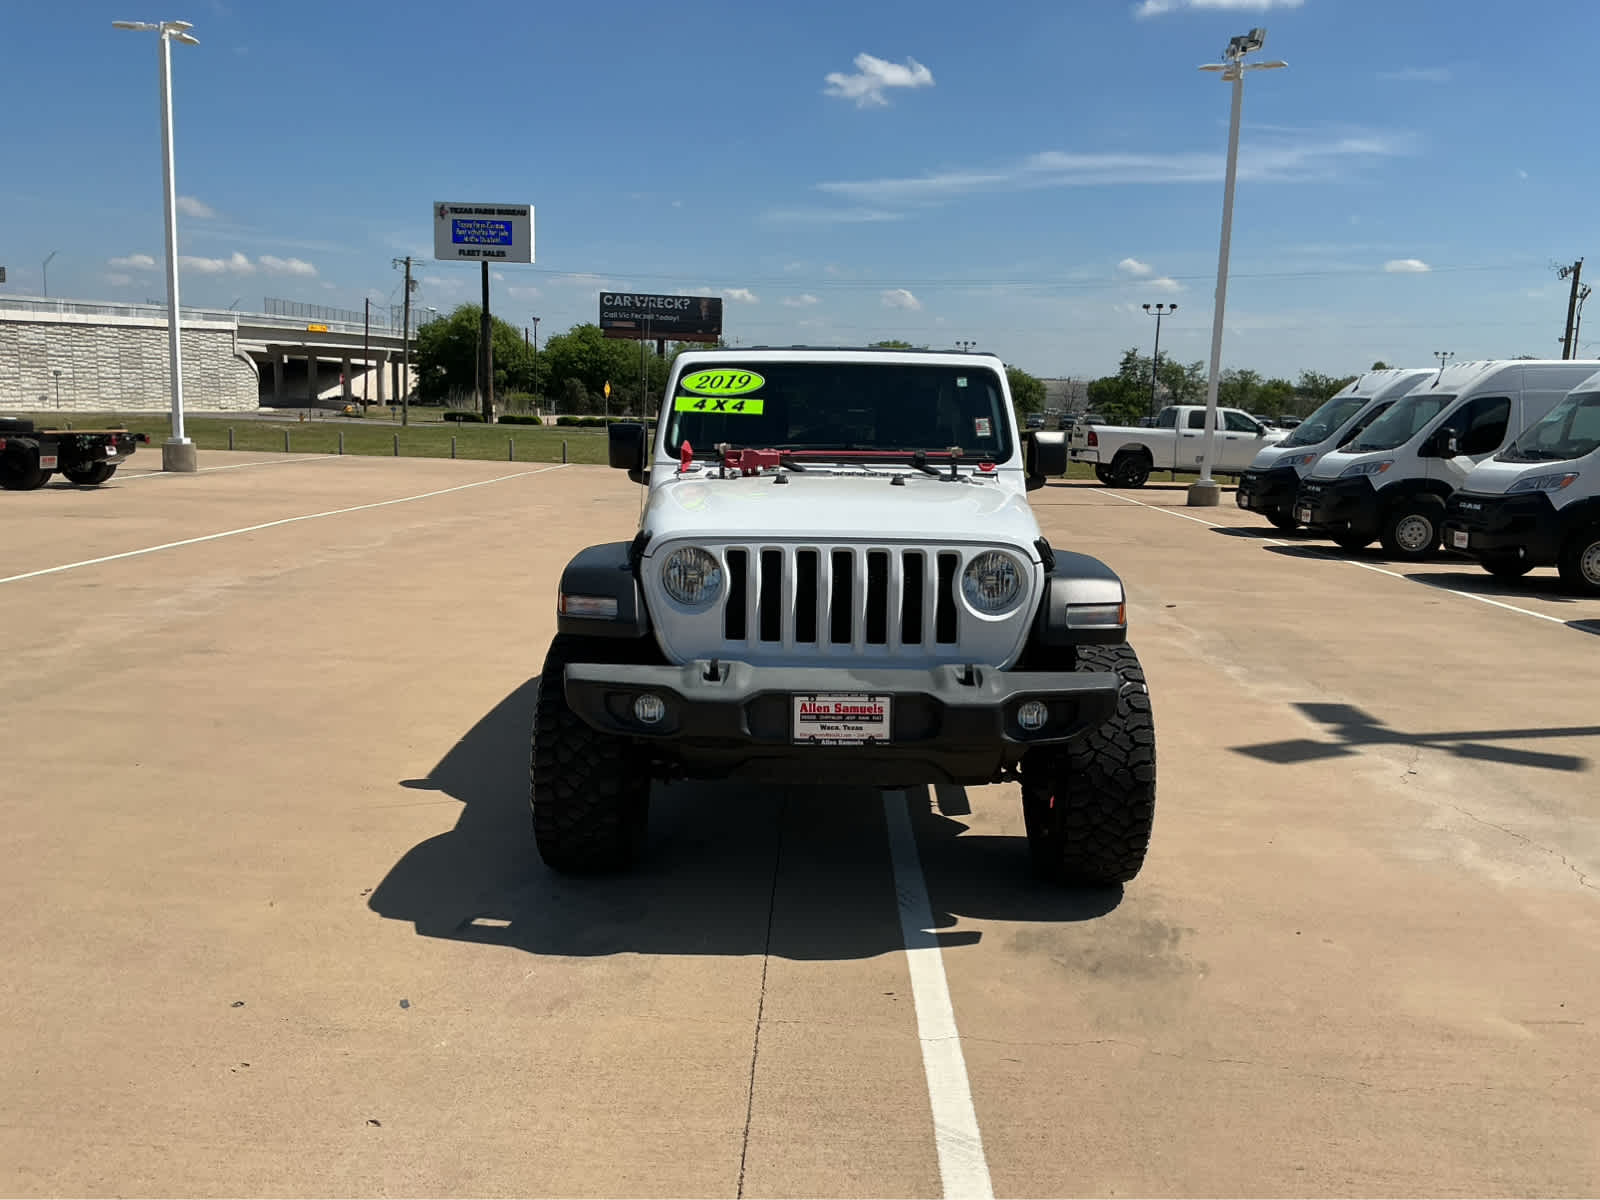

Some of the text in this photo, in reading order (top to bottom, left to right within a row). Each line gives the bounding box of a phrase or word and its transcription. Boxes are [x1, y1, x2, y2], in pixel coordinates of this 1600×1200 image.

[449, 207, 473, 215] TEXAS
[458, 248, 506, 258] FLEET SALES
[603, 295, 691, 310] CAR WRECK?
[602, 311, 618, 319] Call
[695, 374, 752, 390] 2019
[800, 703, 884, 714] Allen Samuels
